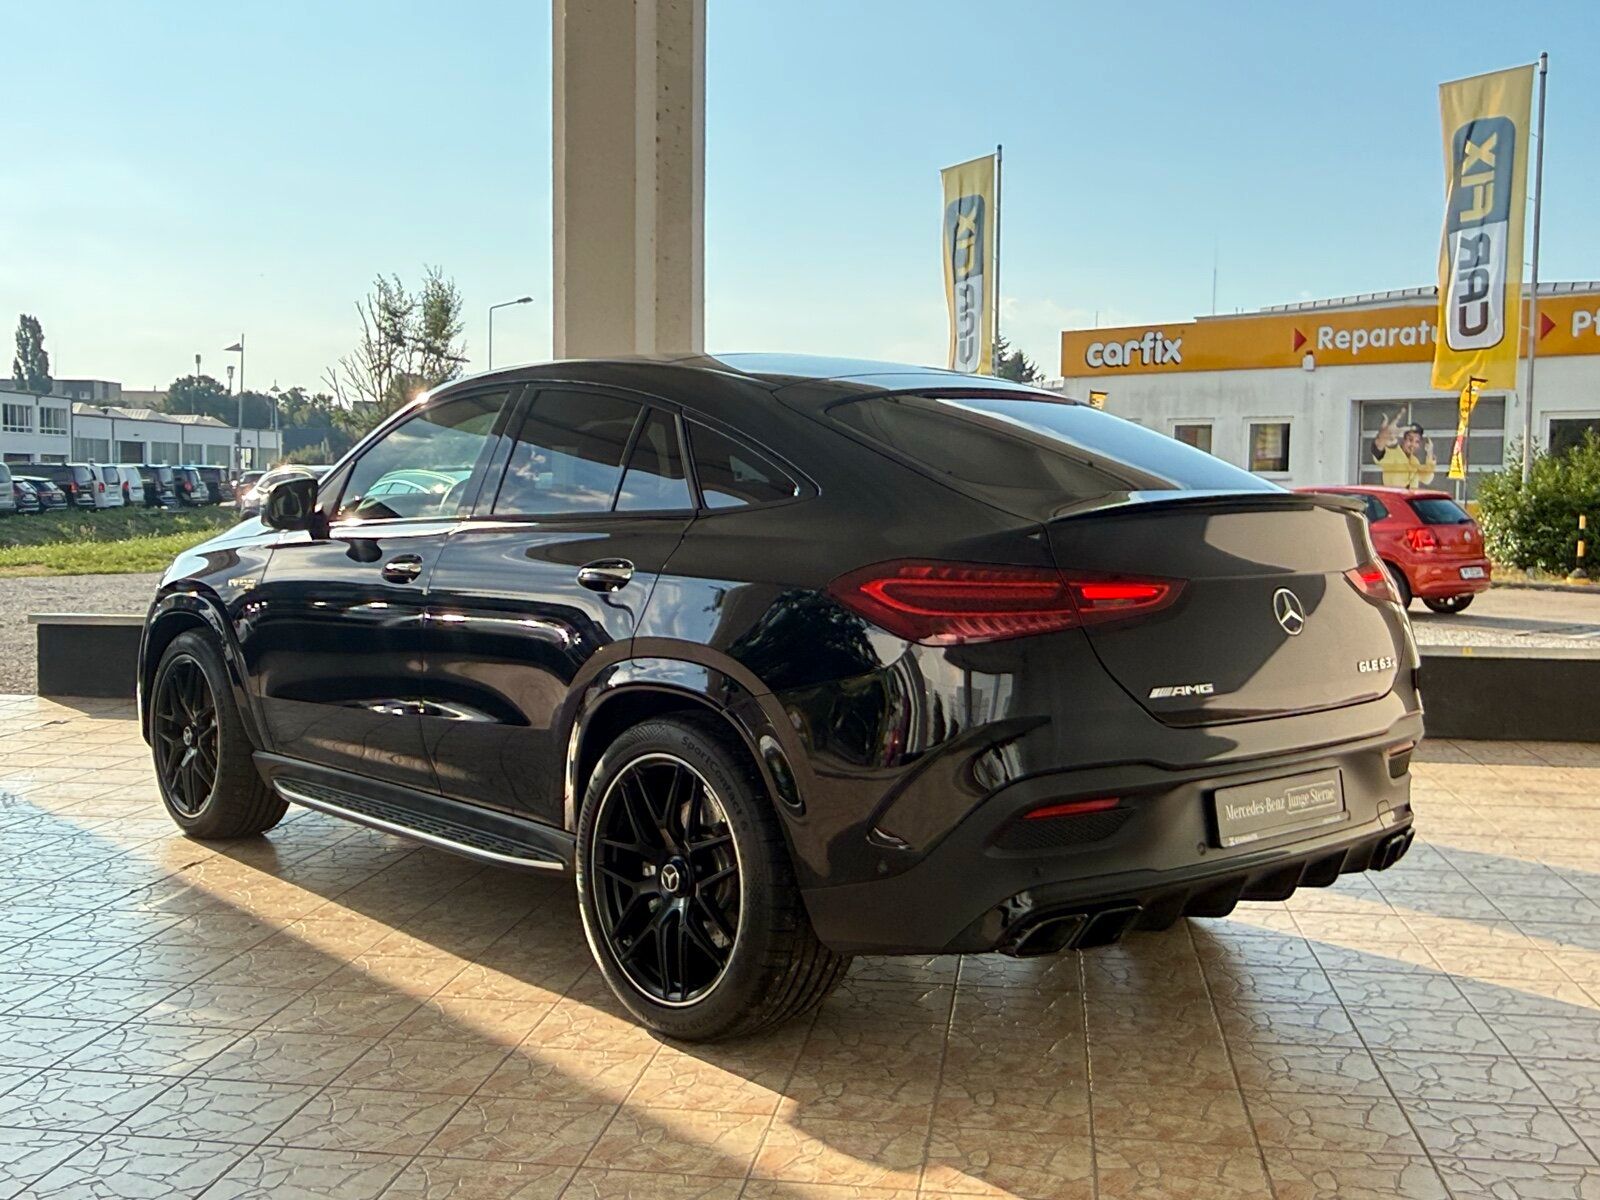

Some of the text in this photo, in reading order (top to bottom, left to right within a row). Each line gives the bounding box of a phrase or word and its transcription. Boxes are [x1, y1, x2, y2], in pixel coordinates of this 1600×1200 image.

[1085, 331, 1182, 368] carfix
[1171, 683, 1214, 697] AMG
[1225, 797, 1286, 821] Mercedes-Benz
